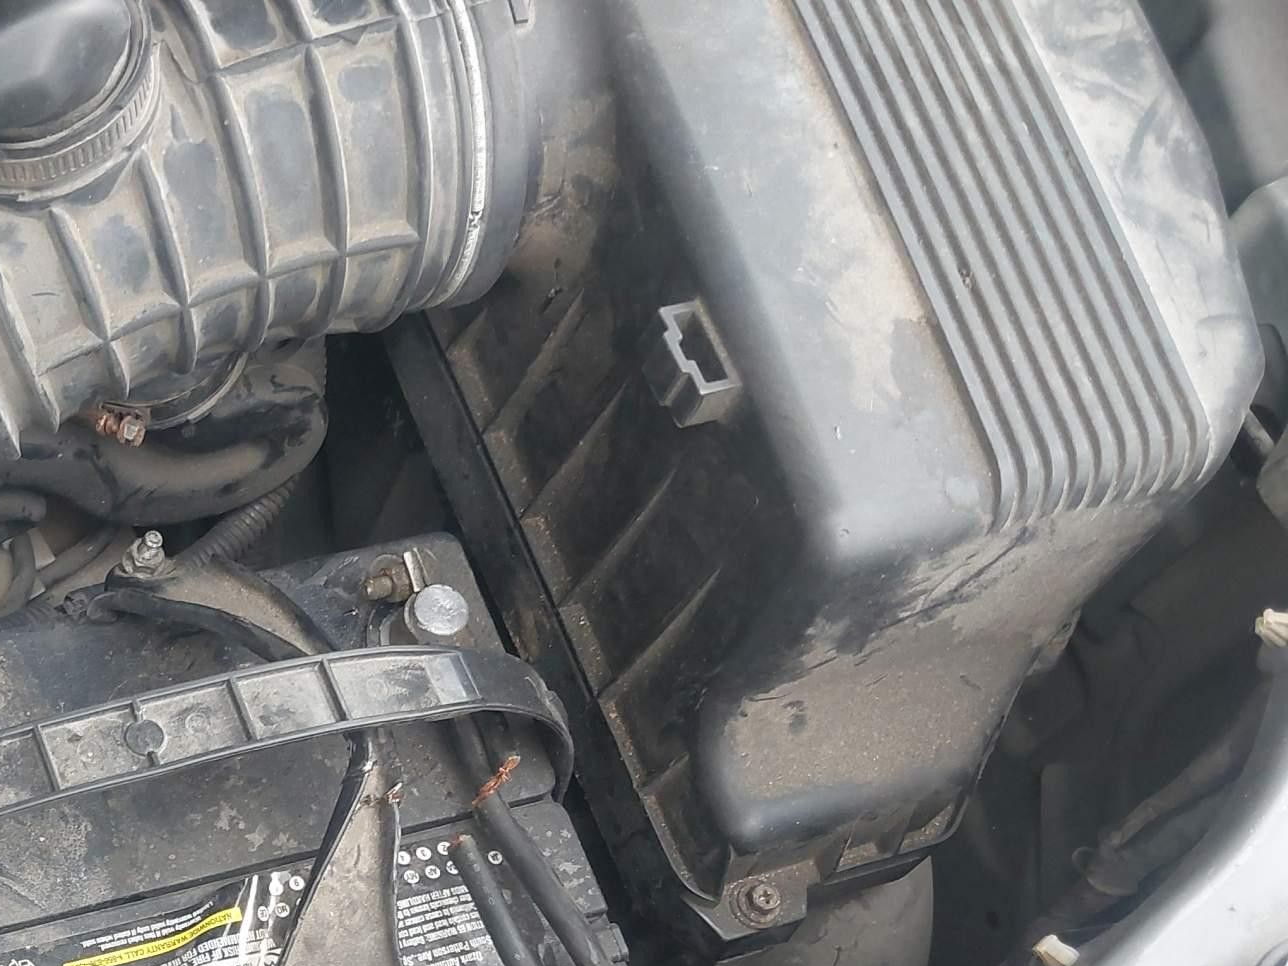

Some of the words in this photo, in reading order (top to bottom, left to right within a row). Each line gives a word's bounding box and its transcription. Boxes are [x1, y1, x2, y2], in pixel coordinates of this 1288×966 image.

[187, 914, 231, 938] NATIONWIDE
[146, 936, 186, 952] WARRANTY
[432, 941, 469, 956] Patterson
[123, 948, 144, 957] CALL
[181, 948, 196, 960] FOR
[209, 949, 222, 959] OF
[459, 951, 482, 964] Ozark
